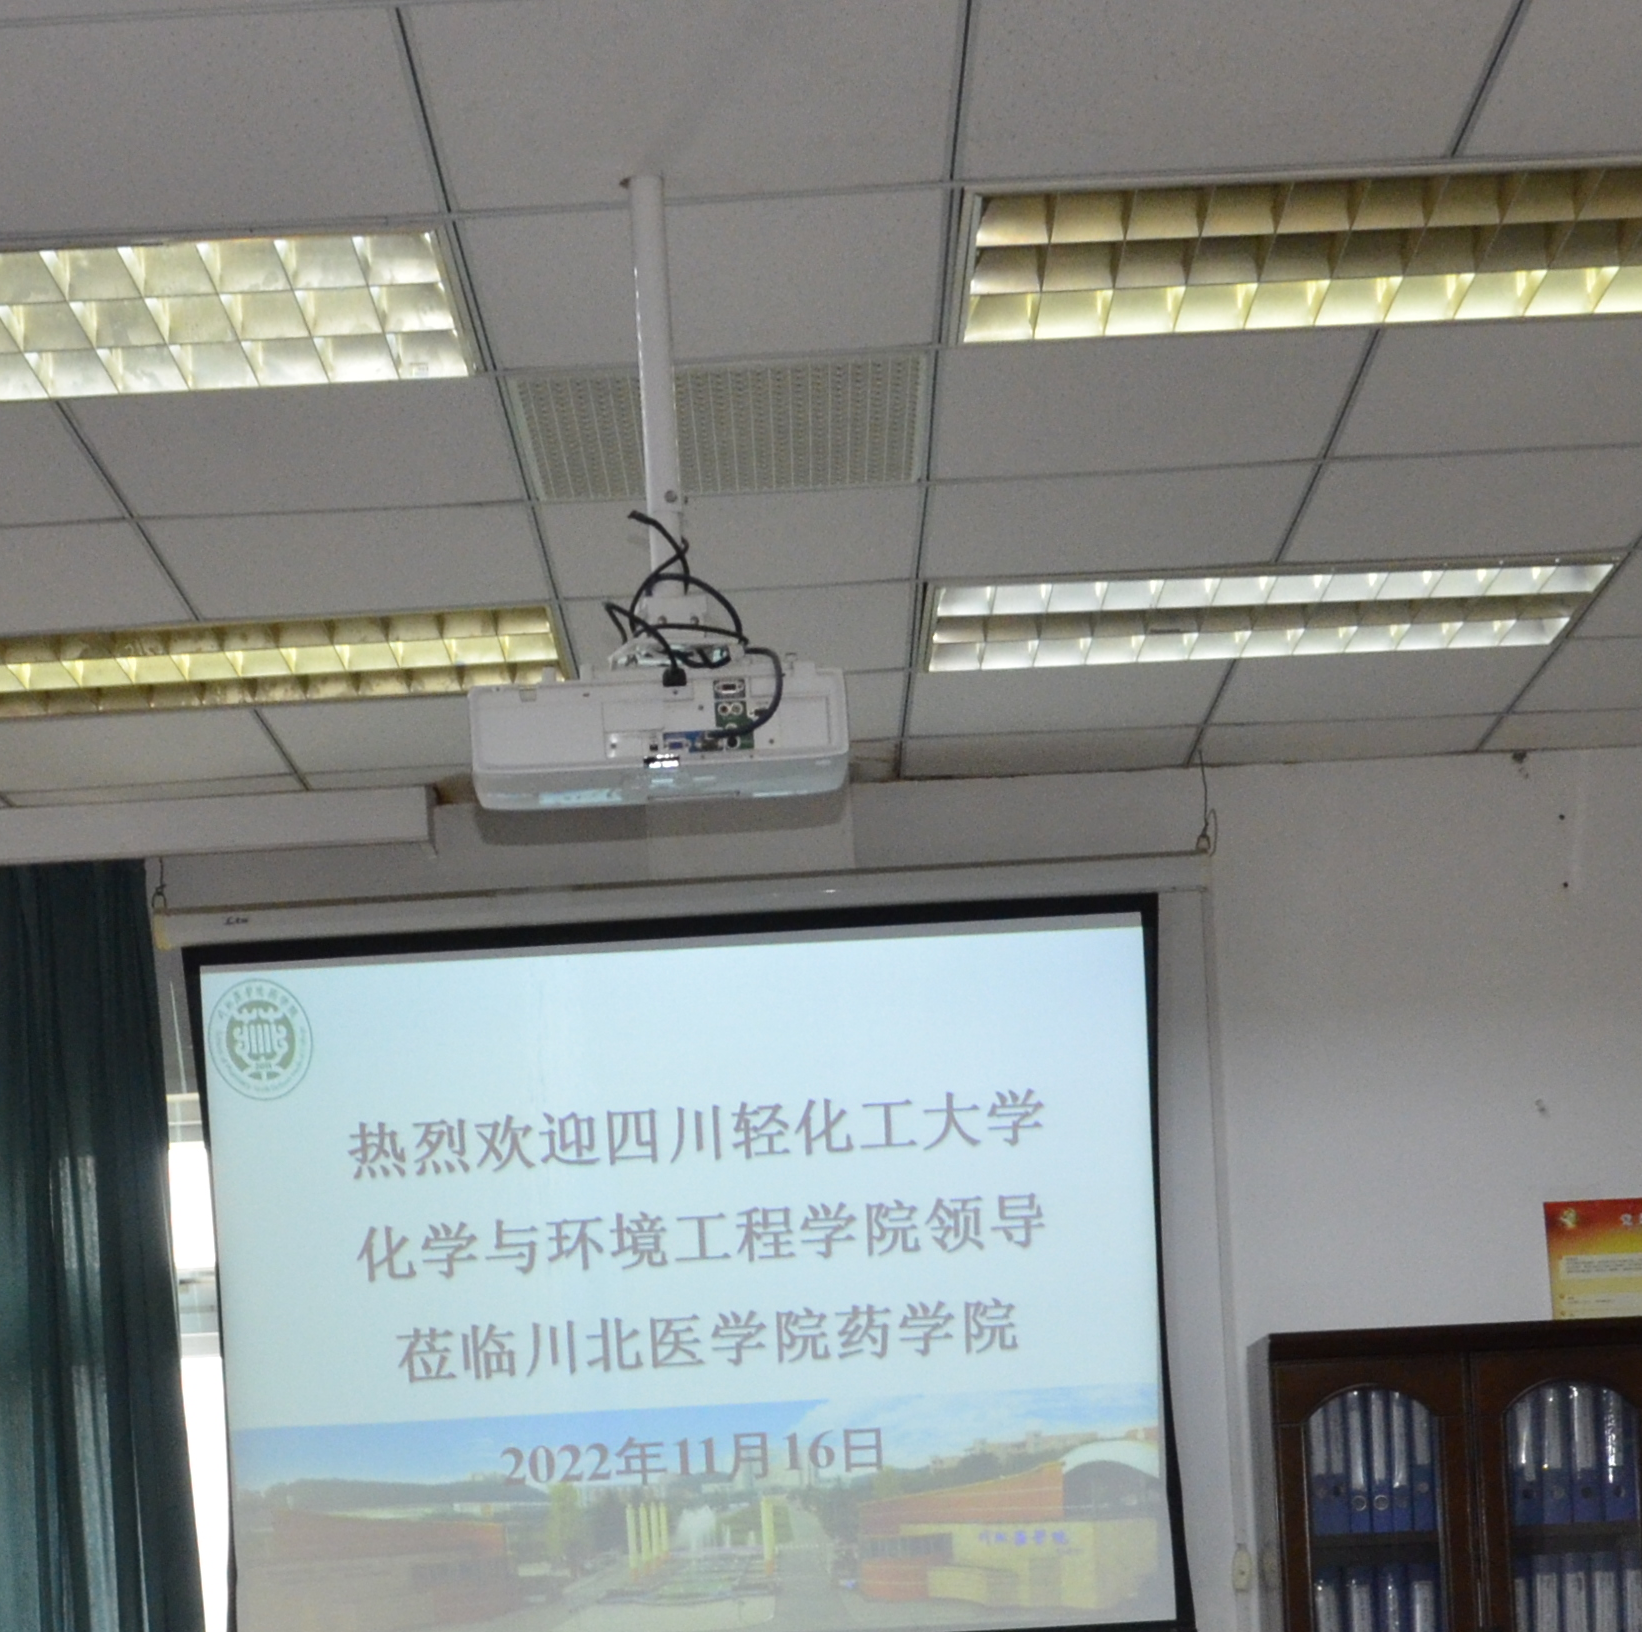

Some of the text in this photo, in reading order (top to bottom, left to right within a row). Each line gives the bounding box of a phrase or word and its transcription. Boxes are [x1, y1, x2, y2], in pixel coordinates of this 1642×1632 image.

[347, 1087, 1047, 1183] 热烈欢迎四川轻化工大学
[356, 1191, 1048, 1284] 化学与环境工程学院领导
[397, 1298, 1019, 1385] 莅临川北医学院药学院
[499, 1427, 883, 1486] 2022年11月16日
